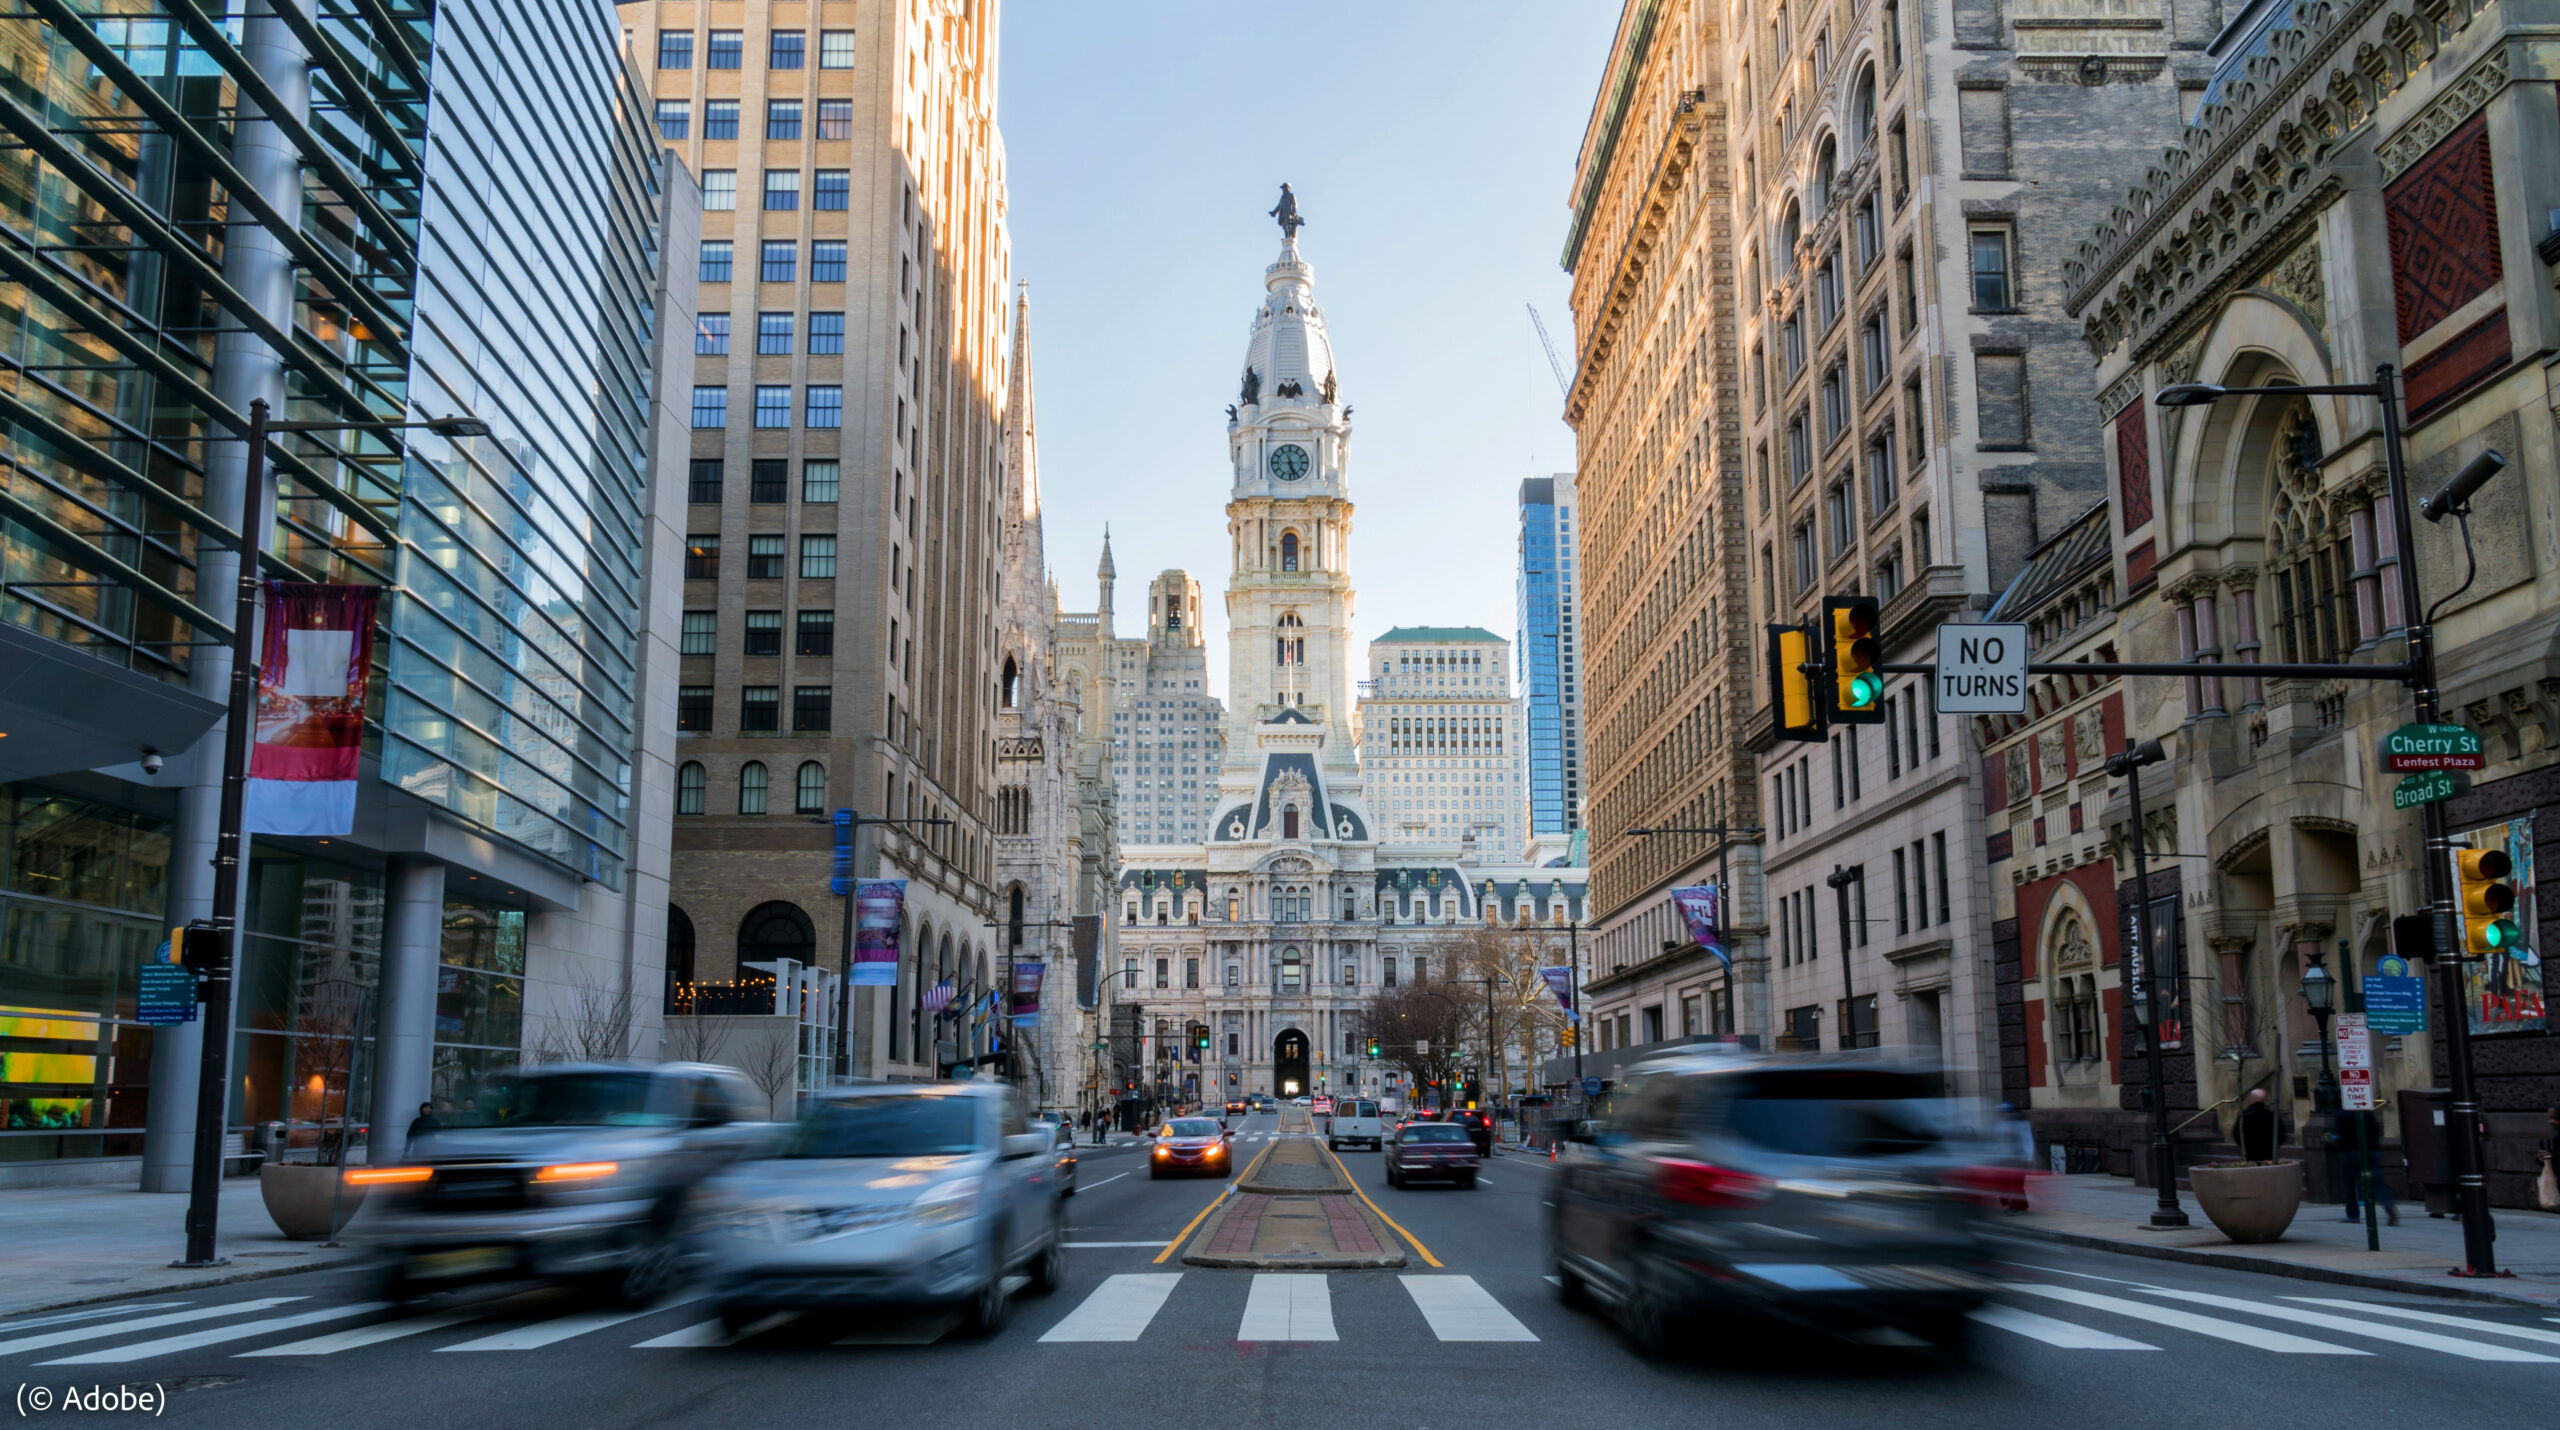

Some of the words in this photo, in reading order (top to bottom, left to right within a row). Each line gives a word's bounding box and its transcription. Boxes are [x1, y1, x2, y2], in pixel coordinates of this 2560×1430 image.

[1960, 637, 2004, 664] NO
[1943, 675, 2019, 697] TURNS
[2428, 725, 2437, 734] W
[2391, 736, 2452, 754] Cherry
[2460, 737, 2478, 752] St
[2397, 758, 2440, 767] Lenfest
[2443, 757, 2475, 767] Plaza
[2395, 782, 2433, 807] Broad
[2438, 779, 2452, 796] St
[2130, 915, 2138, 942] ART
[2131, 945, 2140, 998] MUSEU
[2481, 989, 2546, 1023] PAFA
[2338, 1030, 2348, 1038] NO
[2349, 1071, 2360, 1079] NO
